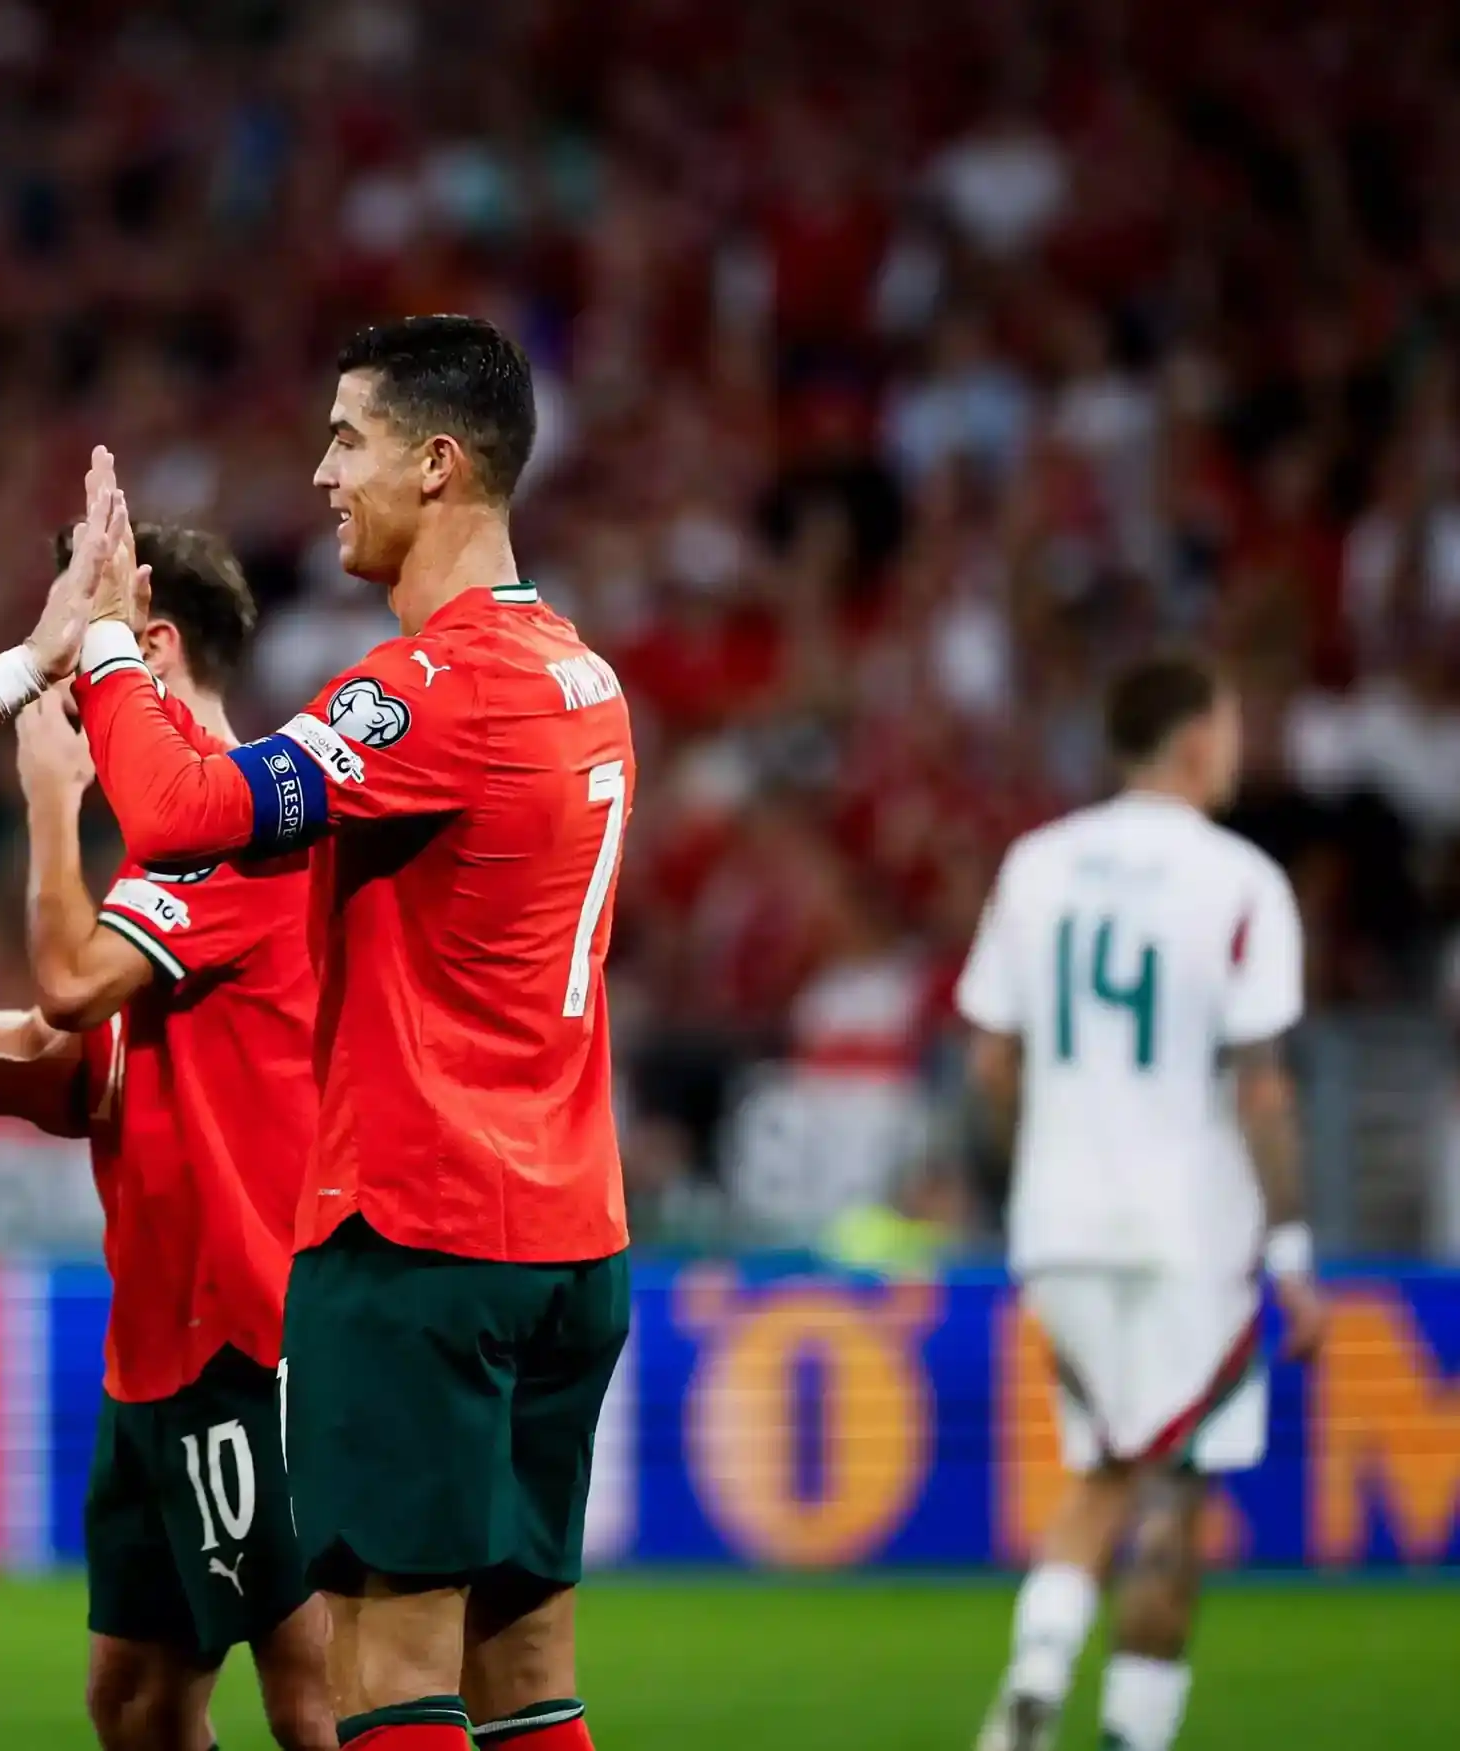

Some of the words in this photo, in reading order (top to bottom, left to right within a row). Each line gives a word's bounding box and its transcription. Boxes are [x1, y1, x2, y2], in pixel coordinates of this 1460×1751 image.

[280, 779, 301, 839] RESPE
[562, 760, 625, 1017] 7
[1056, 914, 1157, 1070] 14
[180, 1418, 256, 1551] 10
